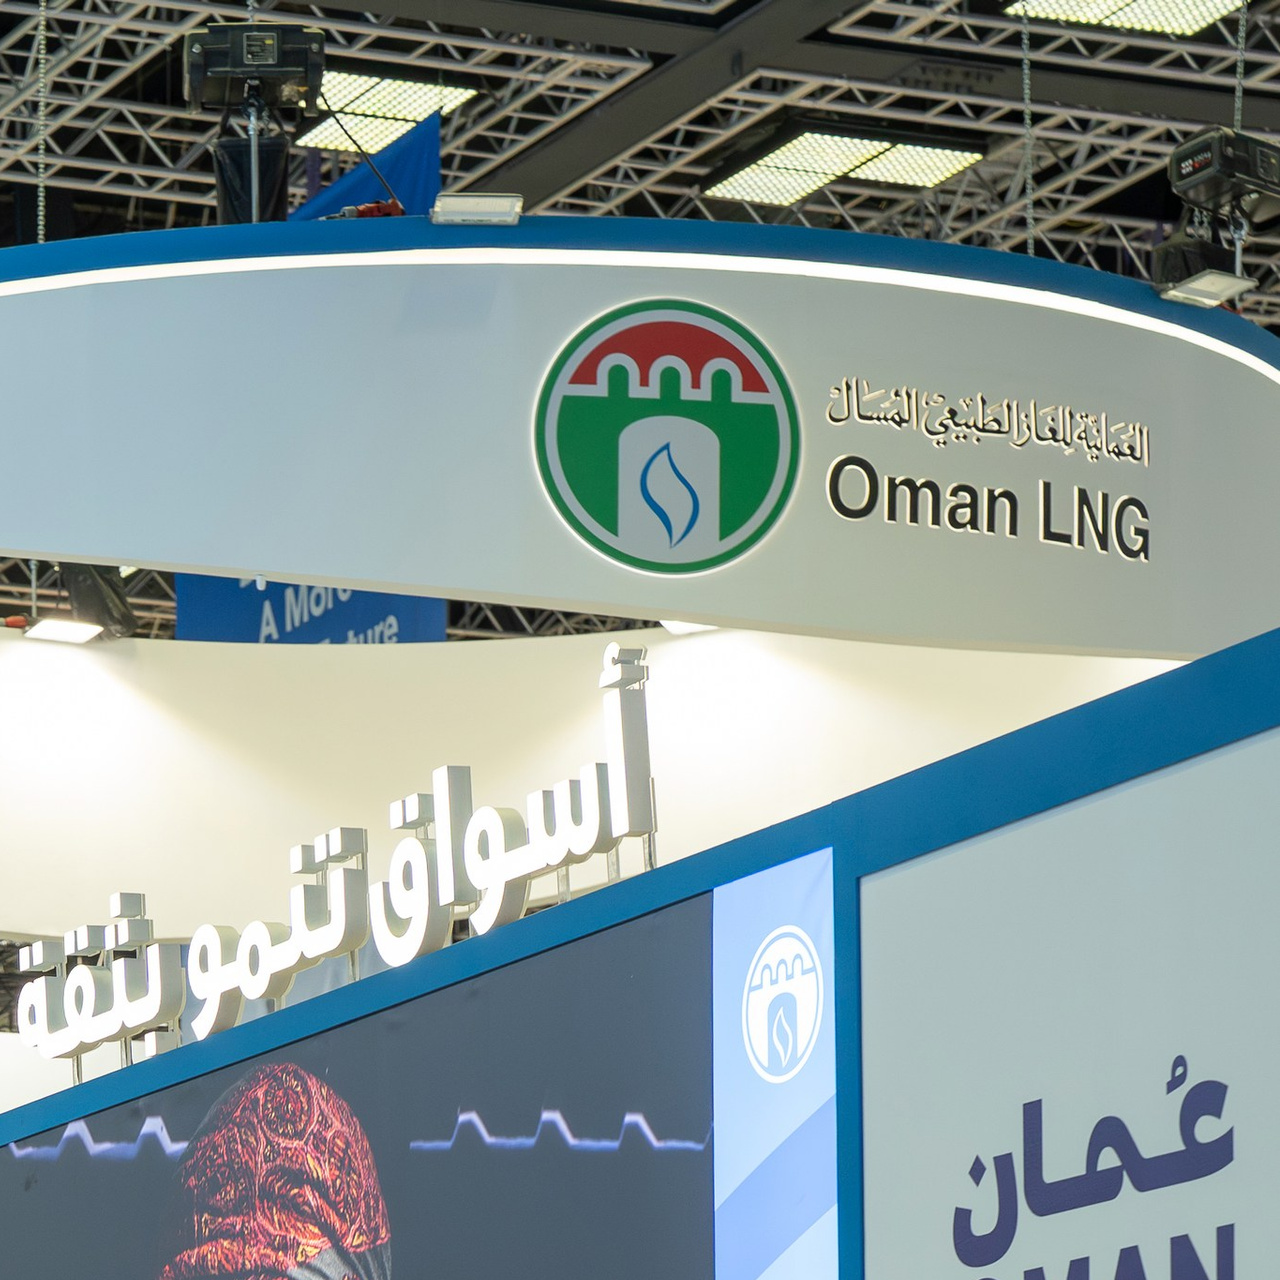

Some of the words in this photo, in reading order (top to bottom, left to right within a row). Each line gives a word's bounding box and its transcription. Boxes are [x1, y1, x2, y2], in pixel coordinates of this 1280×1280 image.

[827, 455, 1019, 538] Oman
[1038, 480, 1151, 562] LNG
[258, 600, 280, 643] A
[370, 641, 650, 968] أسواق
[18, 892, 183, 1058] بثقة
[187, 827, 369, 1041] تنمو
